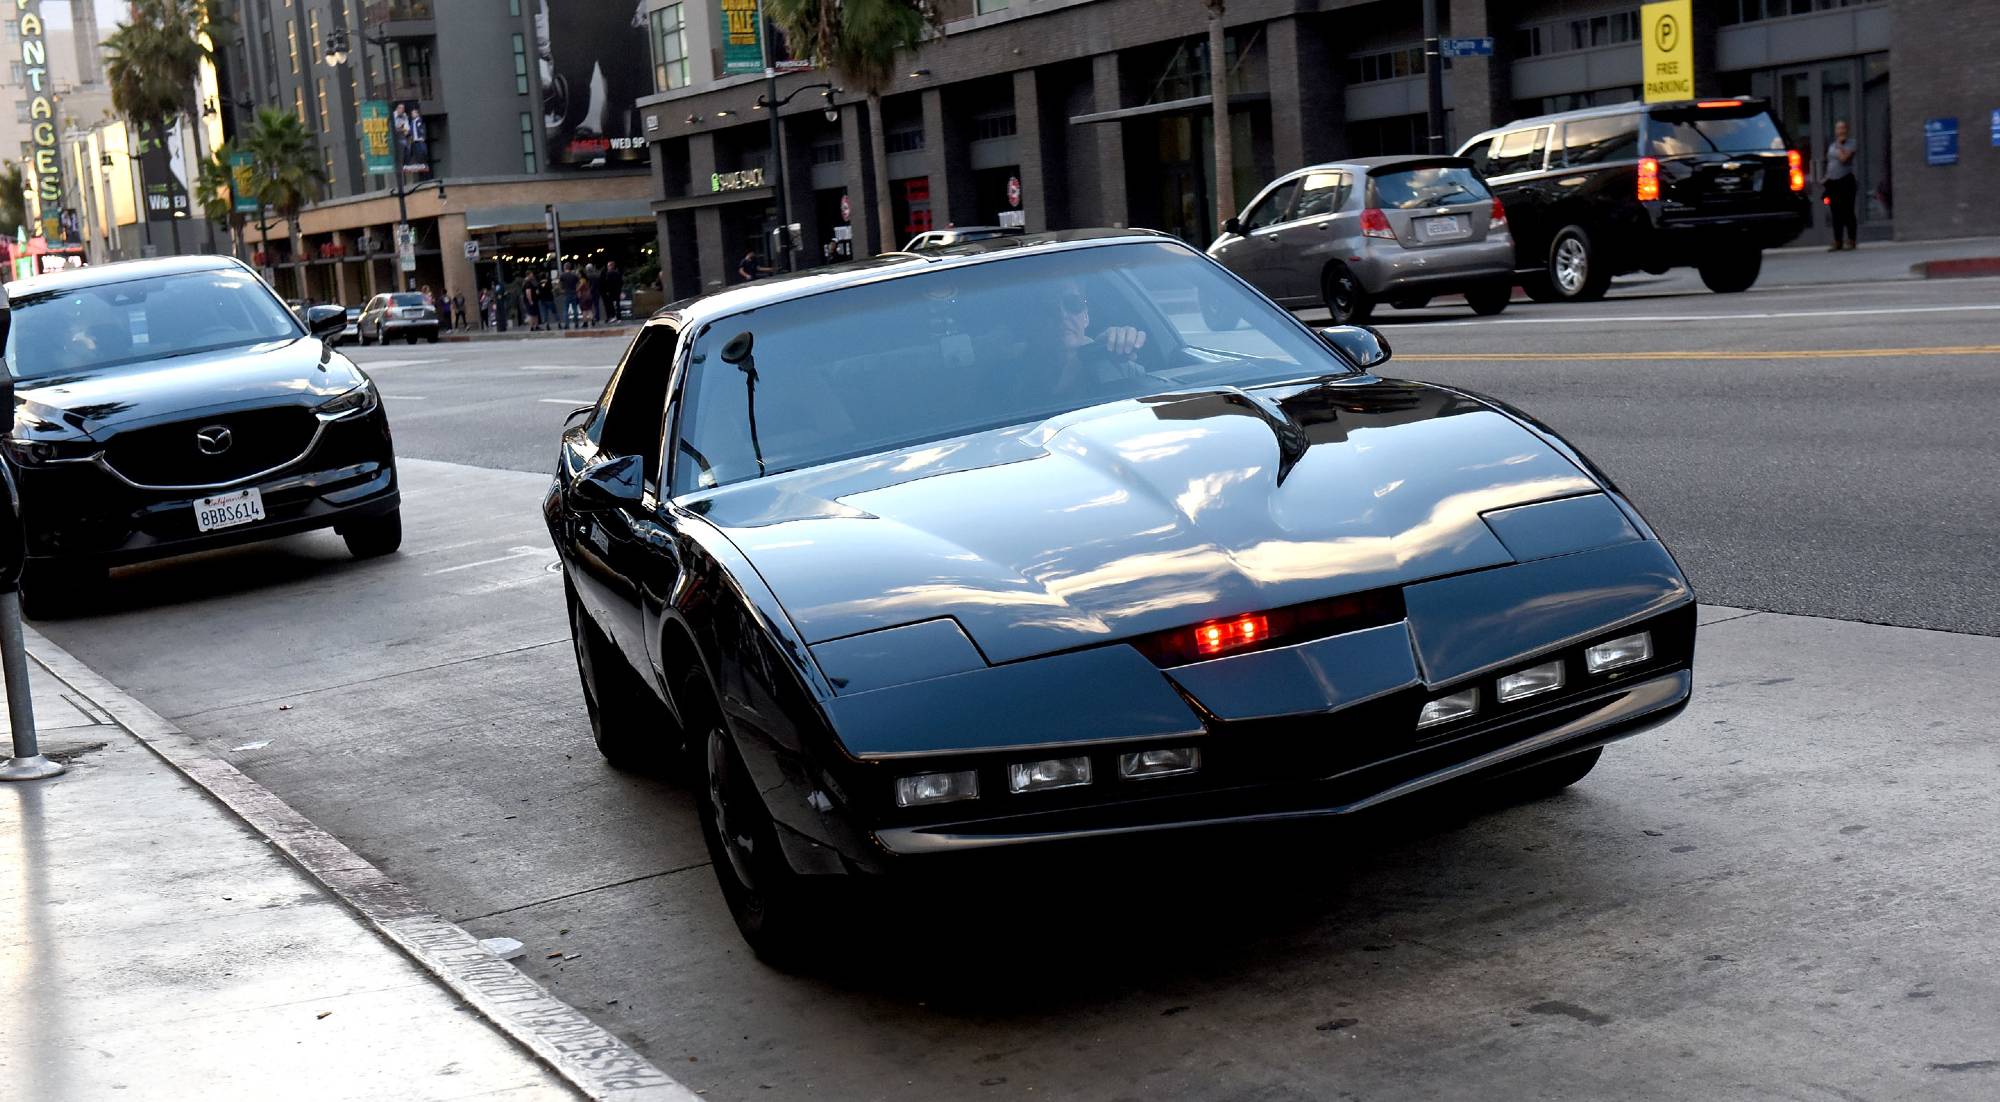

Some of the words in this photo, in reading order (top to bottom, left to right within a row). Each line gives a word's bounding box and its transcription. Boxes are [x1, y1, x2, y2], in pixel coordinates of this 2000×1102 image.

[727, 10, 754, 33] TALE
[1452, 40, 1476, 49] Centro
[1656, 61, 1679, 75] FREE
[1646, 79, 1689, 95] PARKING
[610, 138, 632, 150] WED
[149, 194, 187, 210] WICED
[201, 501, 260, 526] 8BBS614
